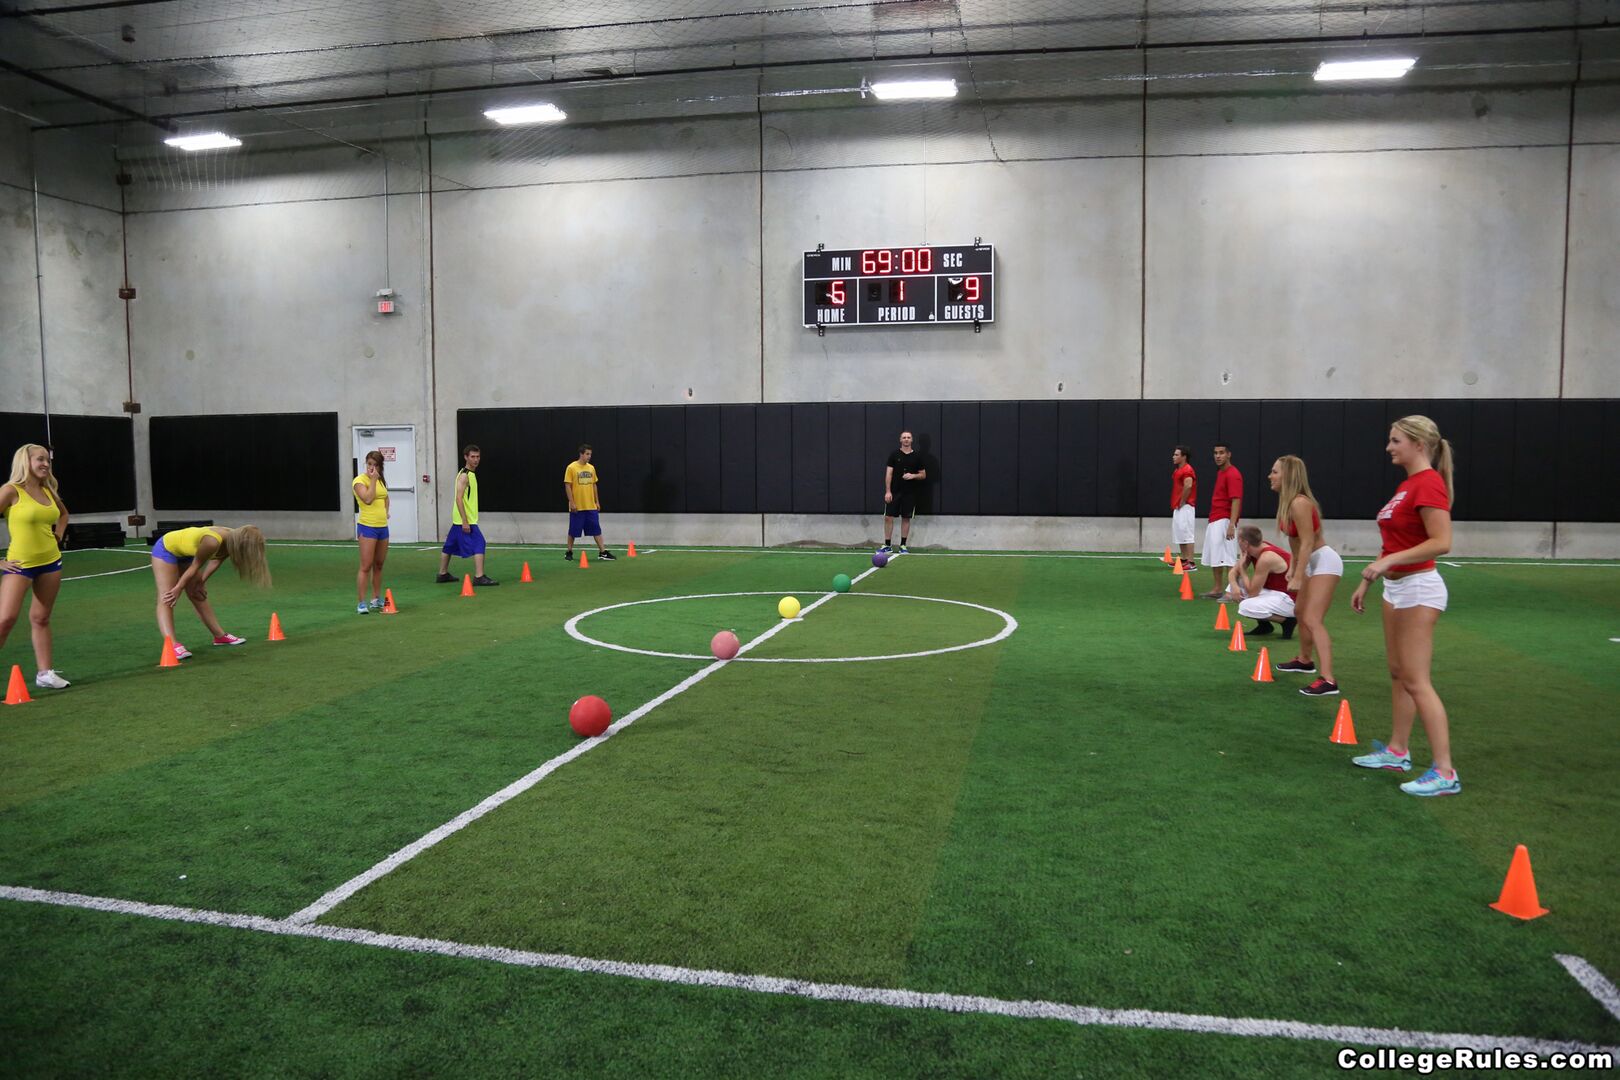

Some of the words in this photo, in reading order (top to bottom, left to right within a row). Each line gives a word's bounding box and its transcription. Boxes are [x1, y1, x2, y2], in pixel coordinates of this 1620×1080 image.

[831, 256, 852, 271] MIN
[862, 248, 931, 274] 69:00
[943, 252, 963, 268] SEC
[899, 280, 904, 301] 1
[965, 276, 980, 300] 9
[817, 308, 845, 323] HOME
[878, 306, 916, 322] PERIOD
[944, 304, 984, 320] GUESTS
